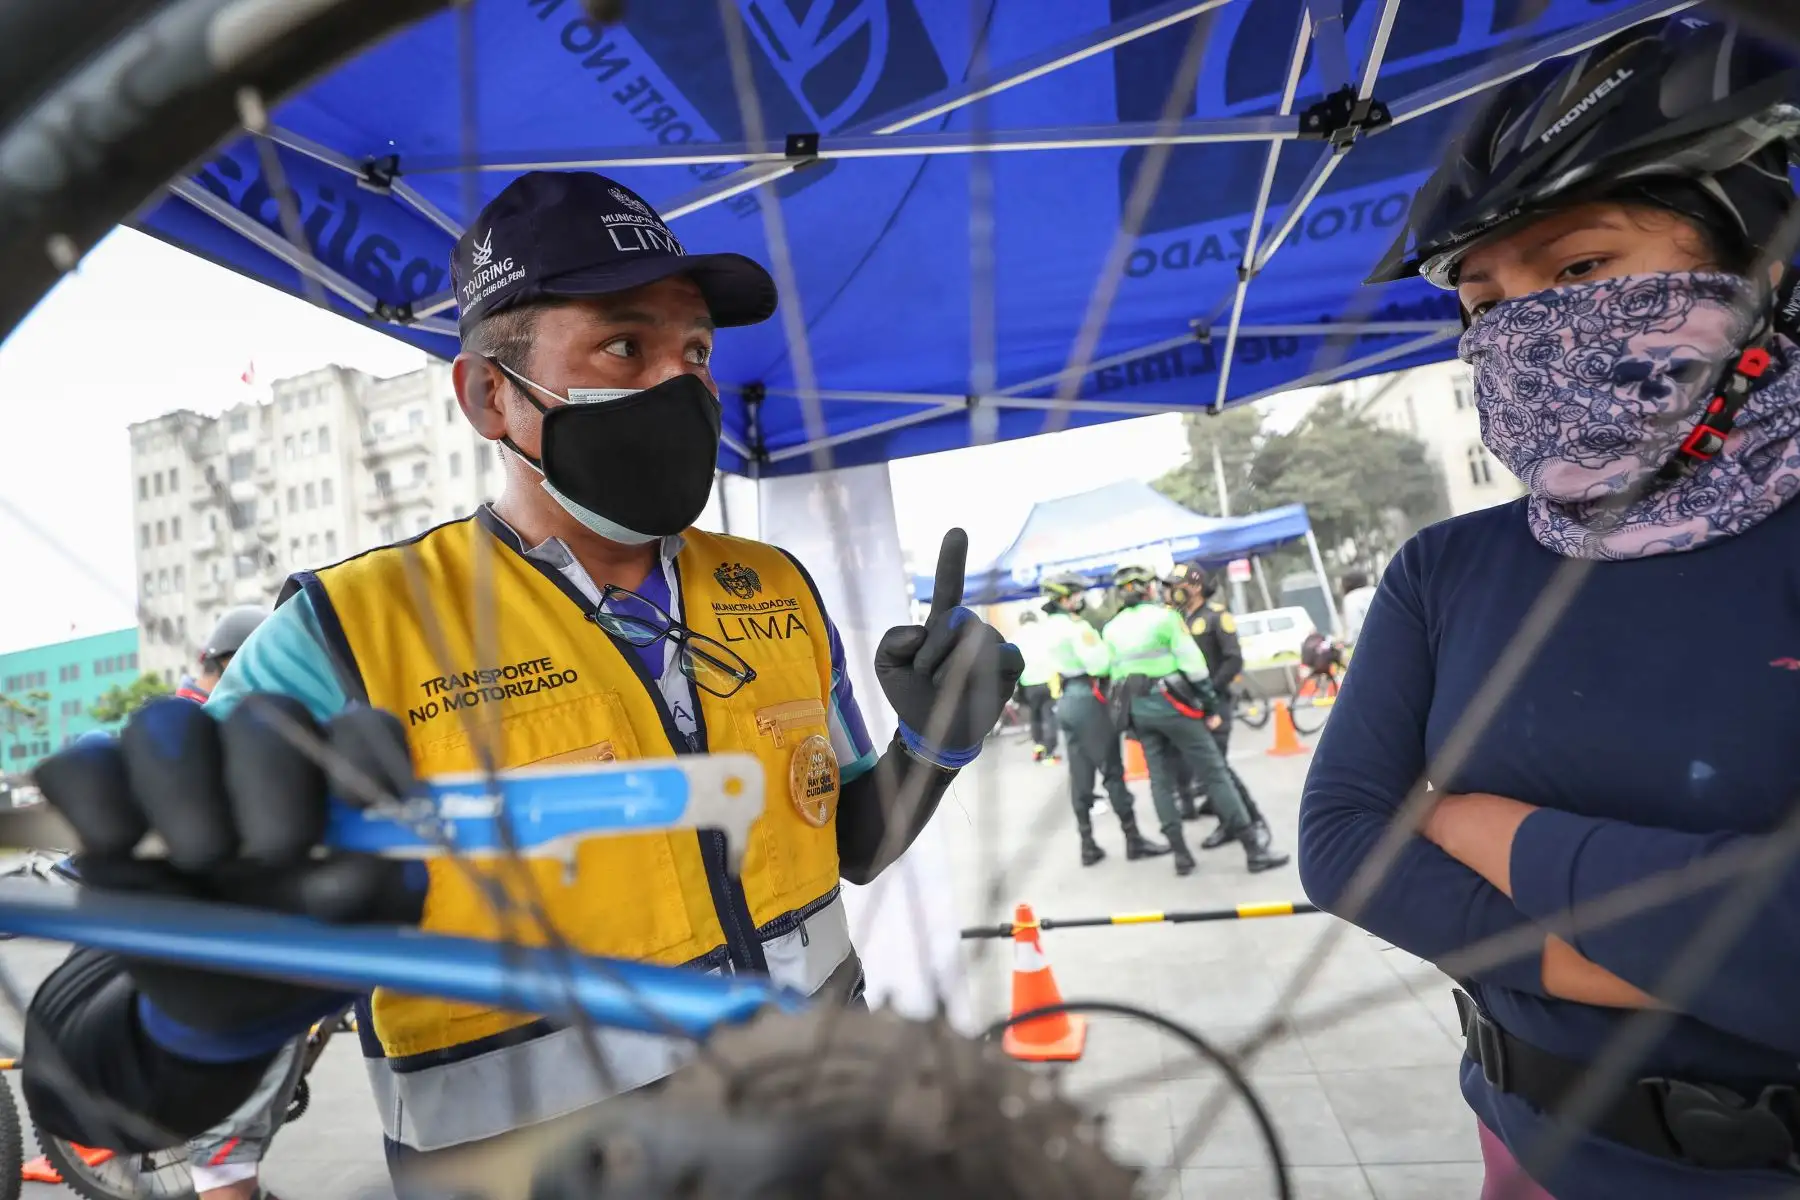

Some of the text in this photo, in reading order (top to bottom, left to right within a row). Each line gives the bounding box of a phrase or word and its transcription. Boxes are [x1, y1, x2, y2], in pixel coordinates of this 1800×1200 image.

[1540, 66, 1635, 143] PROWELL
[463, 257, 514, 301] TOURING
[482, 265, 525, 298] CLUB DEL PERÚ
[711, 598, 798, 612] MUNICIPALIDAD DE
[717, 613, 809, 642] LIMA
[420, 656, 555, 698] TRANSPORTE
[408, 669, 579, 726] NO MOTORIZADO
[812, 752, 823, 763] NO
